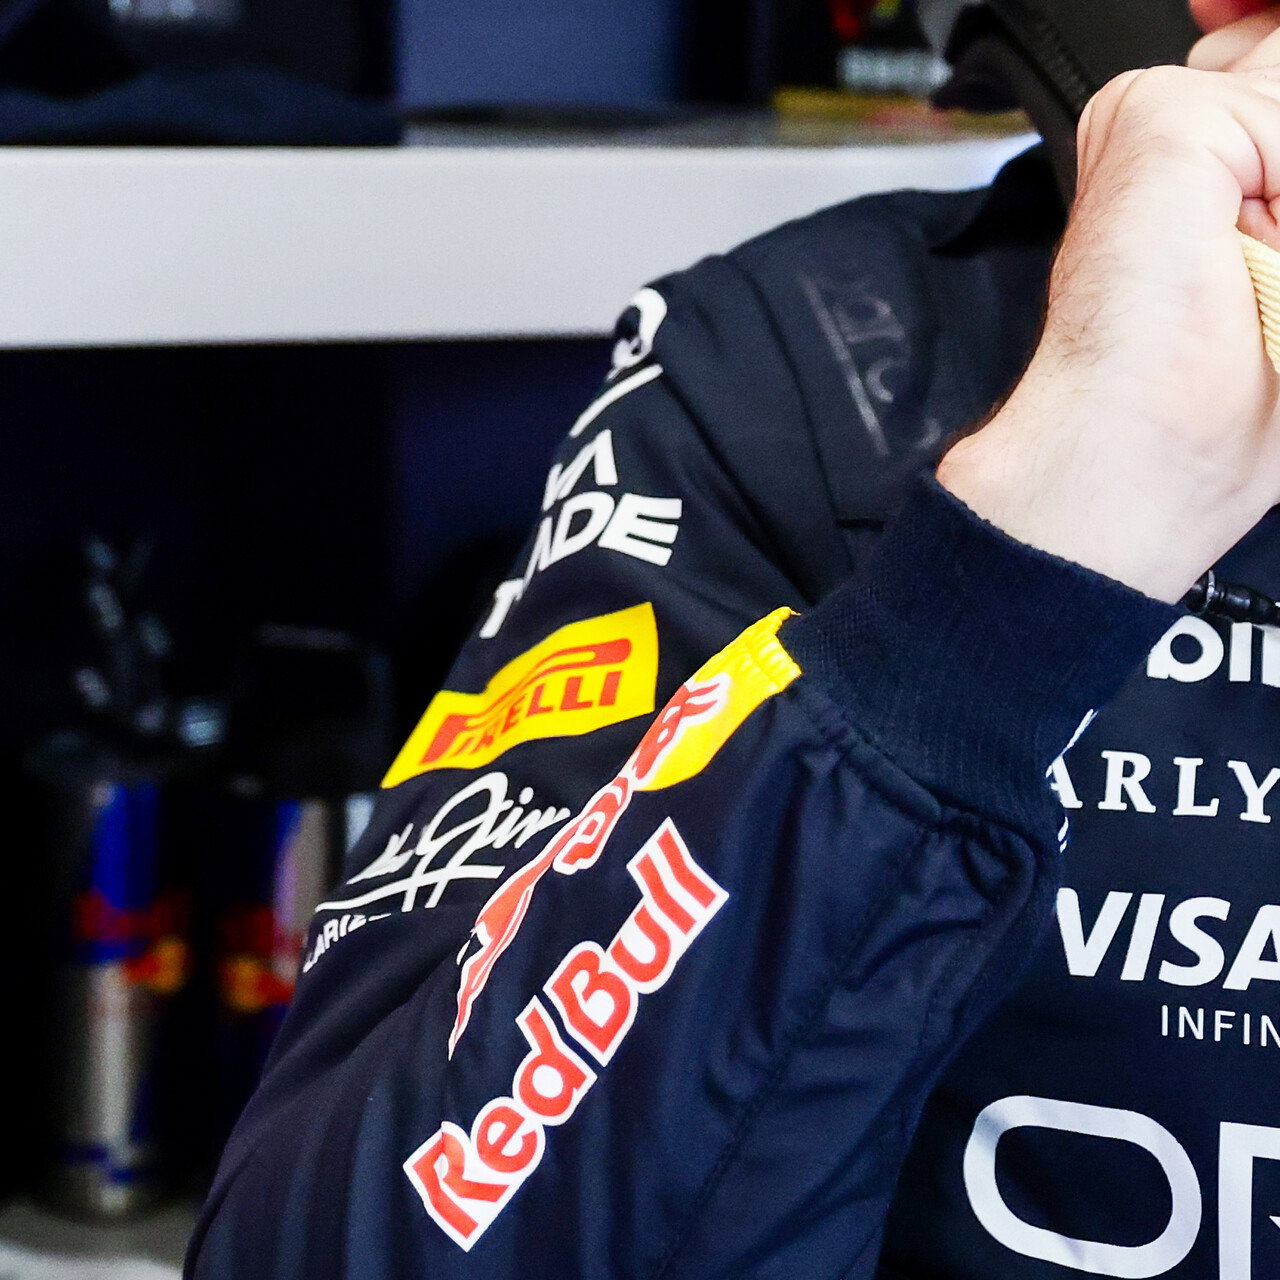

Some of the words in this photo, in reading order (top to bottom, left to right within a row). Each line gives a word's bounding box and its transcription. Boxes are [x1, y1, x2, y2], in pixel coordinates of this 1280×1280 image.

[420, 638, 632, 765] PIRELLI
[403, 995, 597, 1252] Red
[543, 816, 730, 1067] Bull
